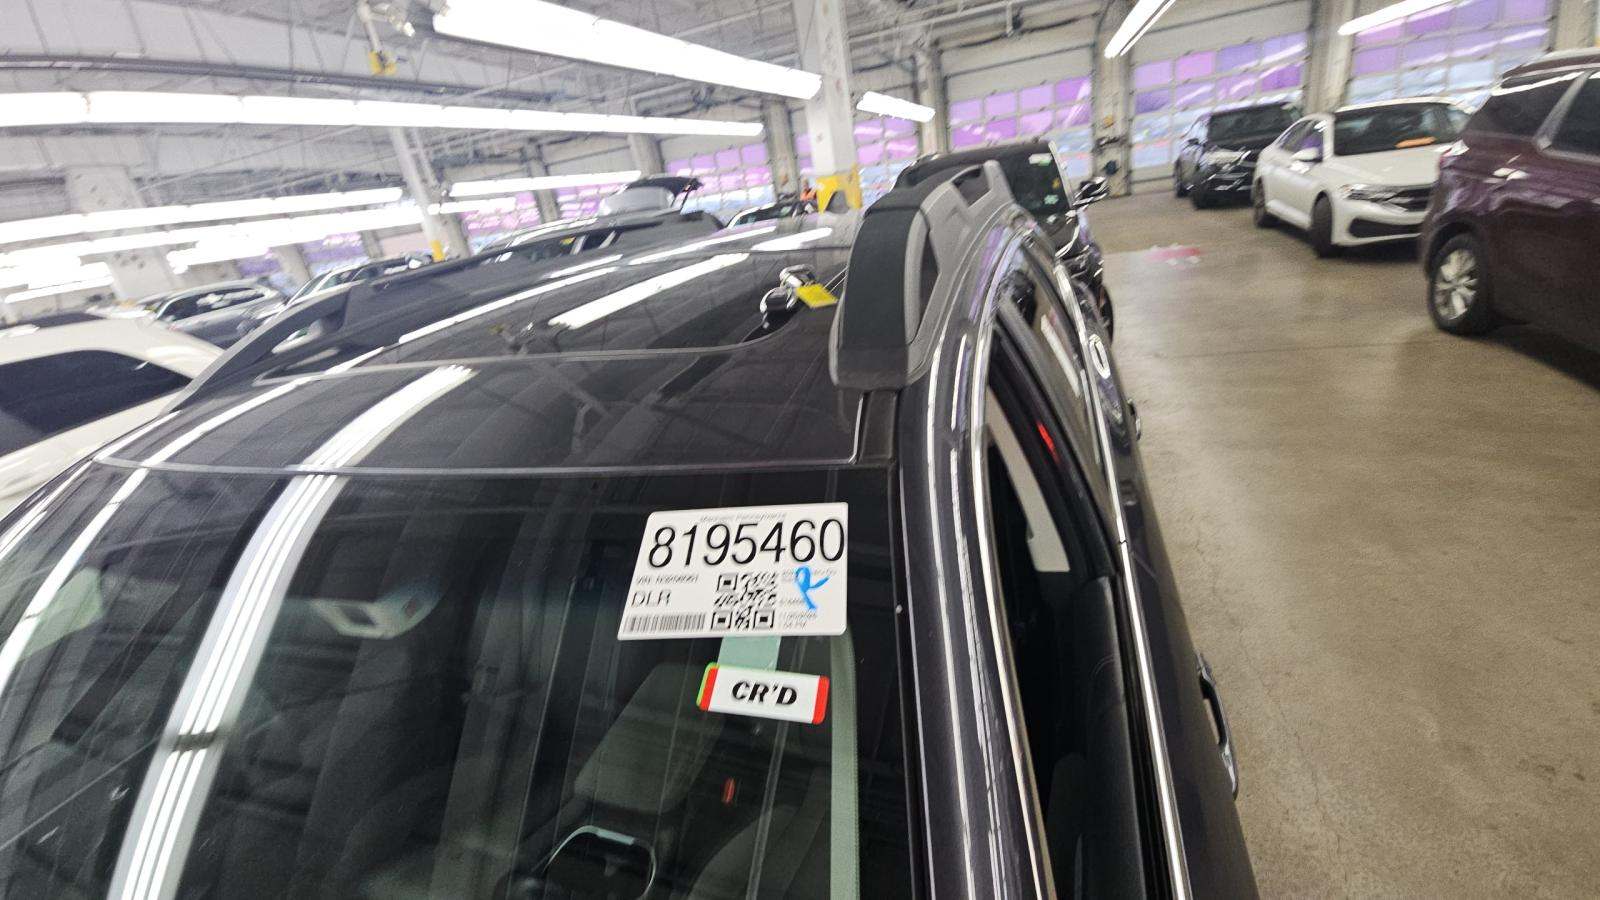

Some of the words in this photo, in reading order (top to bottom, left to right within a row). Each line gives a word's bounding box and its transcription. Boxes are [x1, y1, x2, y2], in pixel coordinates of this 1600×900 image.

[648, 519, 845, 568] 8195460
[631, 590, 671, 608] DLR
[732, 680, 797, 706] CR'D
